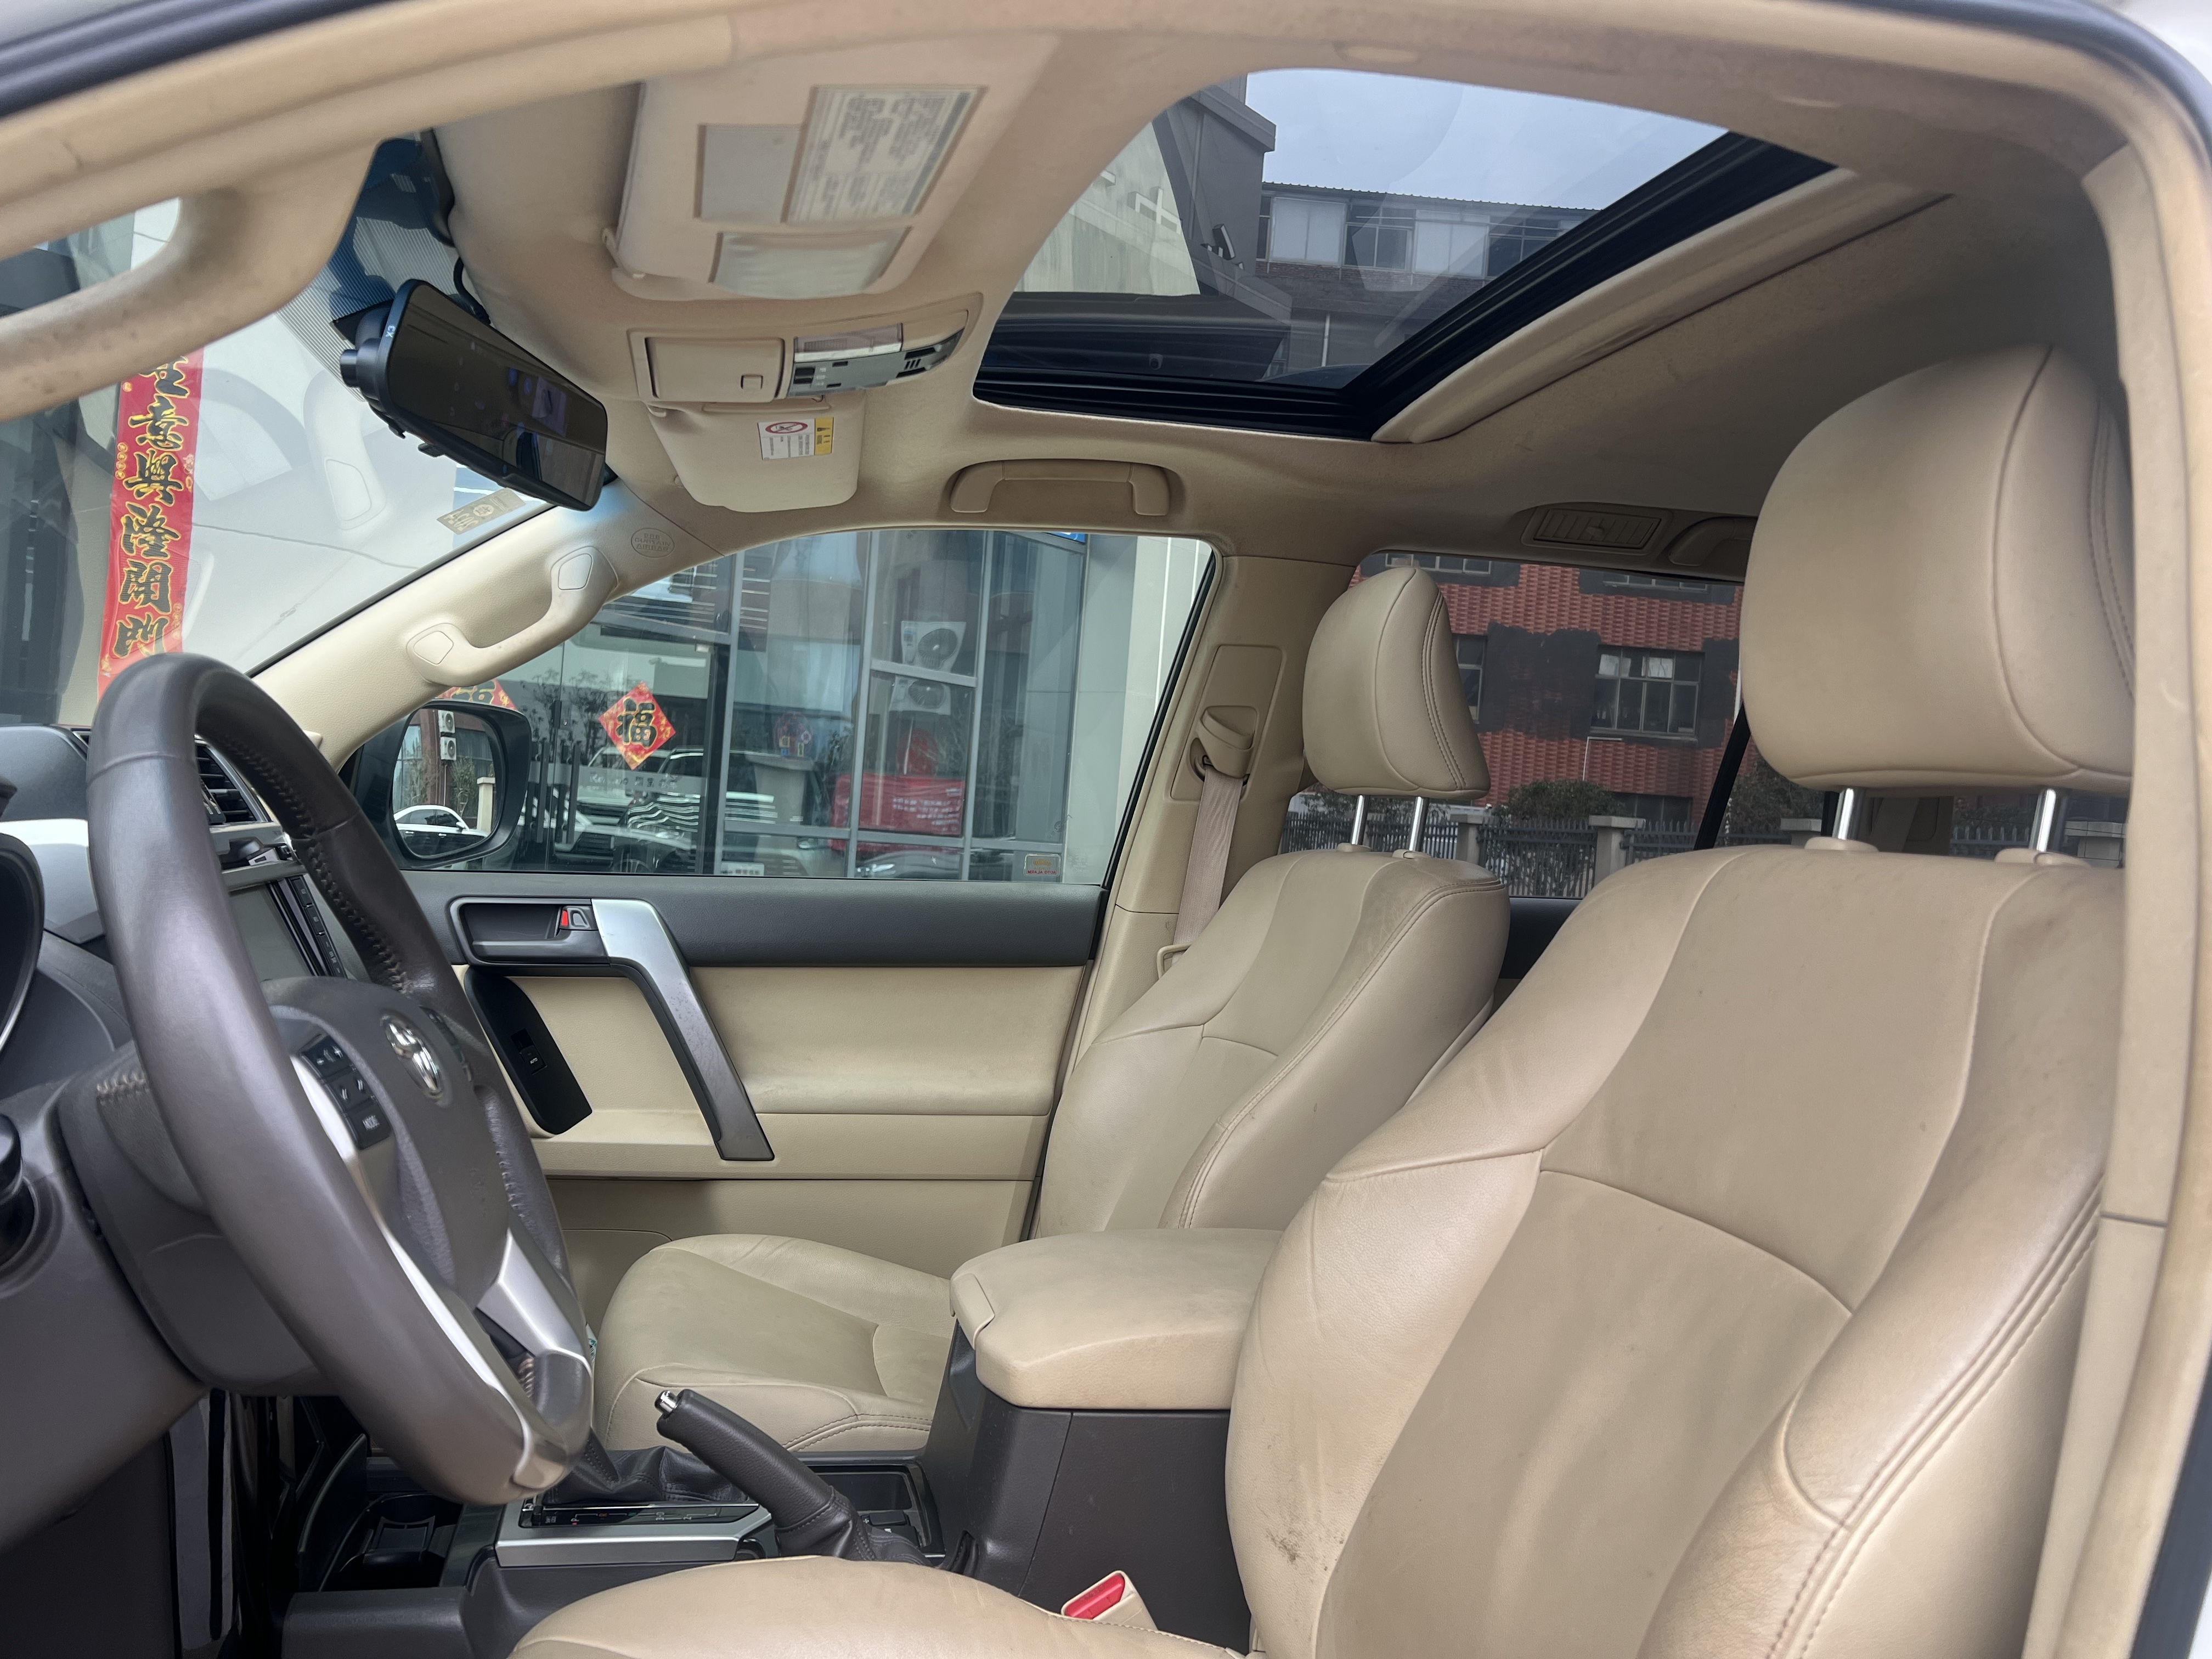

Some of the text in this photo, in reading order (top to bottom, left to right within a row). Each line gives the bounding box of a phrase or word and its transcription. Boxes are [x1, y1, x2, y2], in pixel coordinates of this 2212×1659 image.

[634, 537, 671, 546] CURTAIN
[636, 544, 669, 552] AIRBAG
[615, 696, 658, 749] 福
